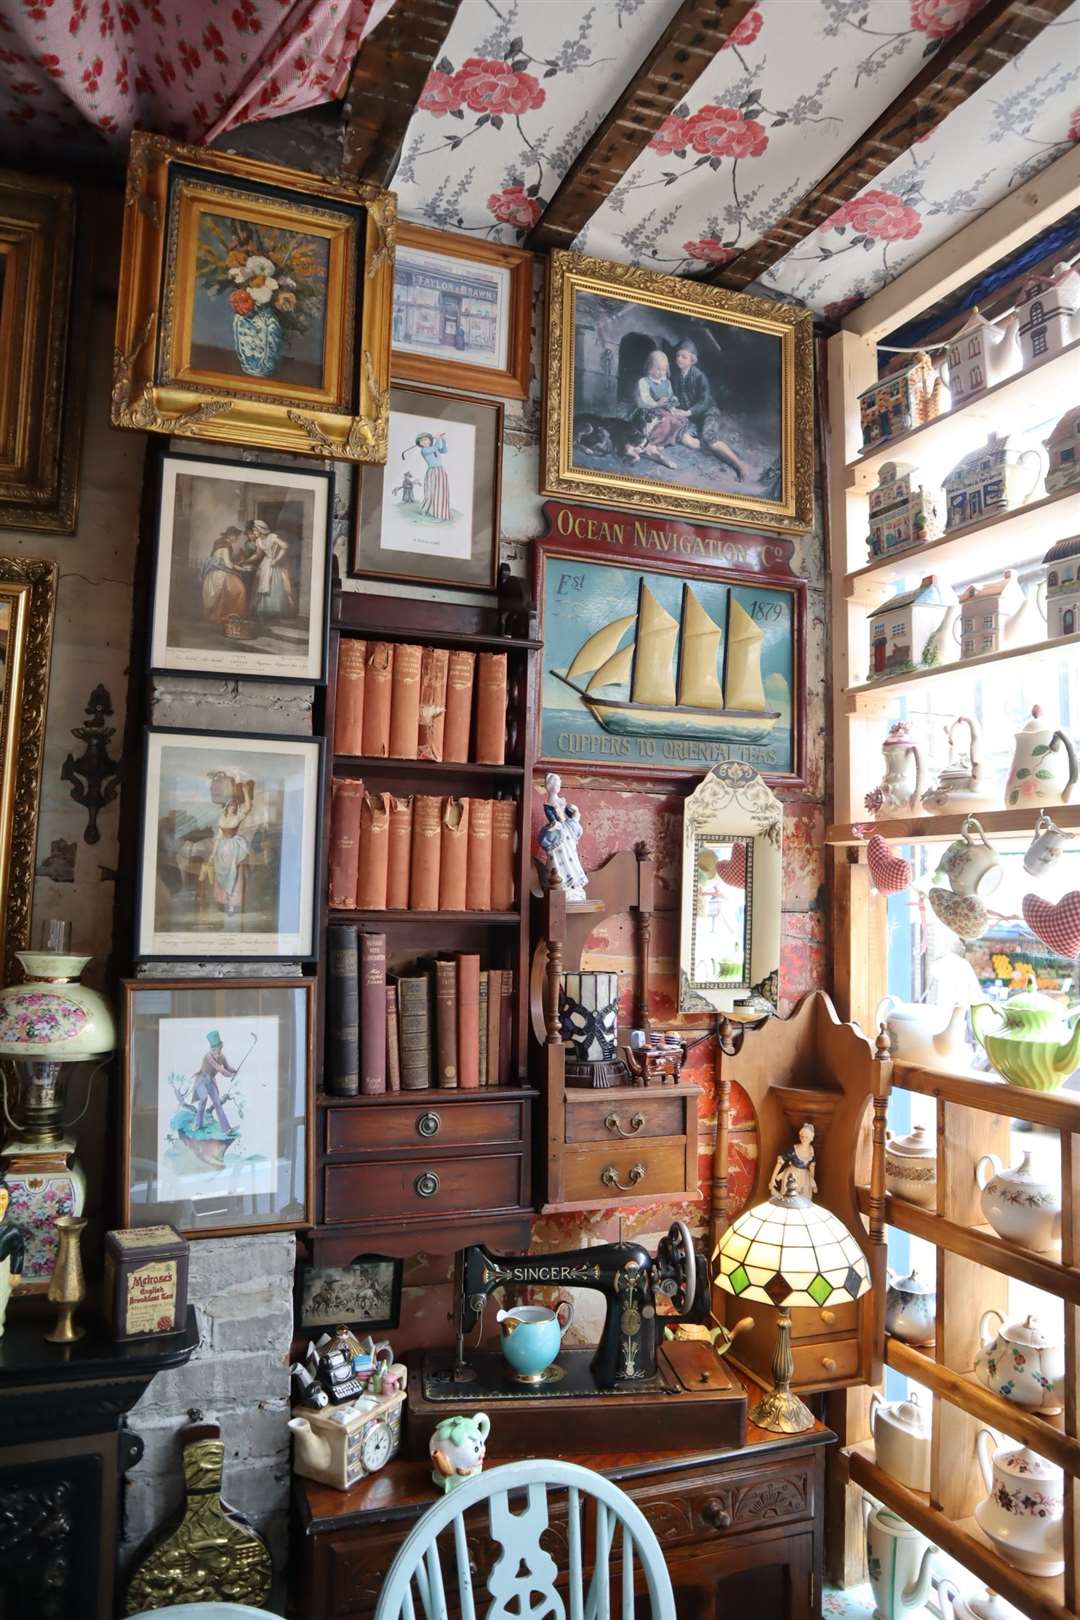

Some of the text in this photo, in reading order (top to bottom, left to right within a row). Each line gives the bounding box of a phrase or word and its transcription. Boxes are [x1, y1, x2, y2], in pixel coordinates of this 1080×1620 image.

[751, 600, 782, 621] 1879
[638, 738, 656, 757] TO
[514, 1267, 572, 1281] SINGER
